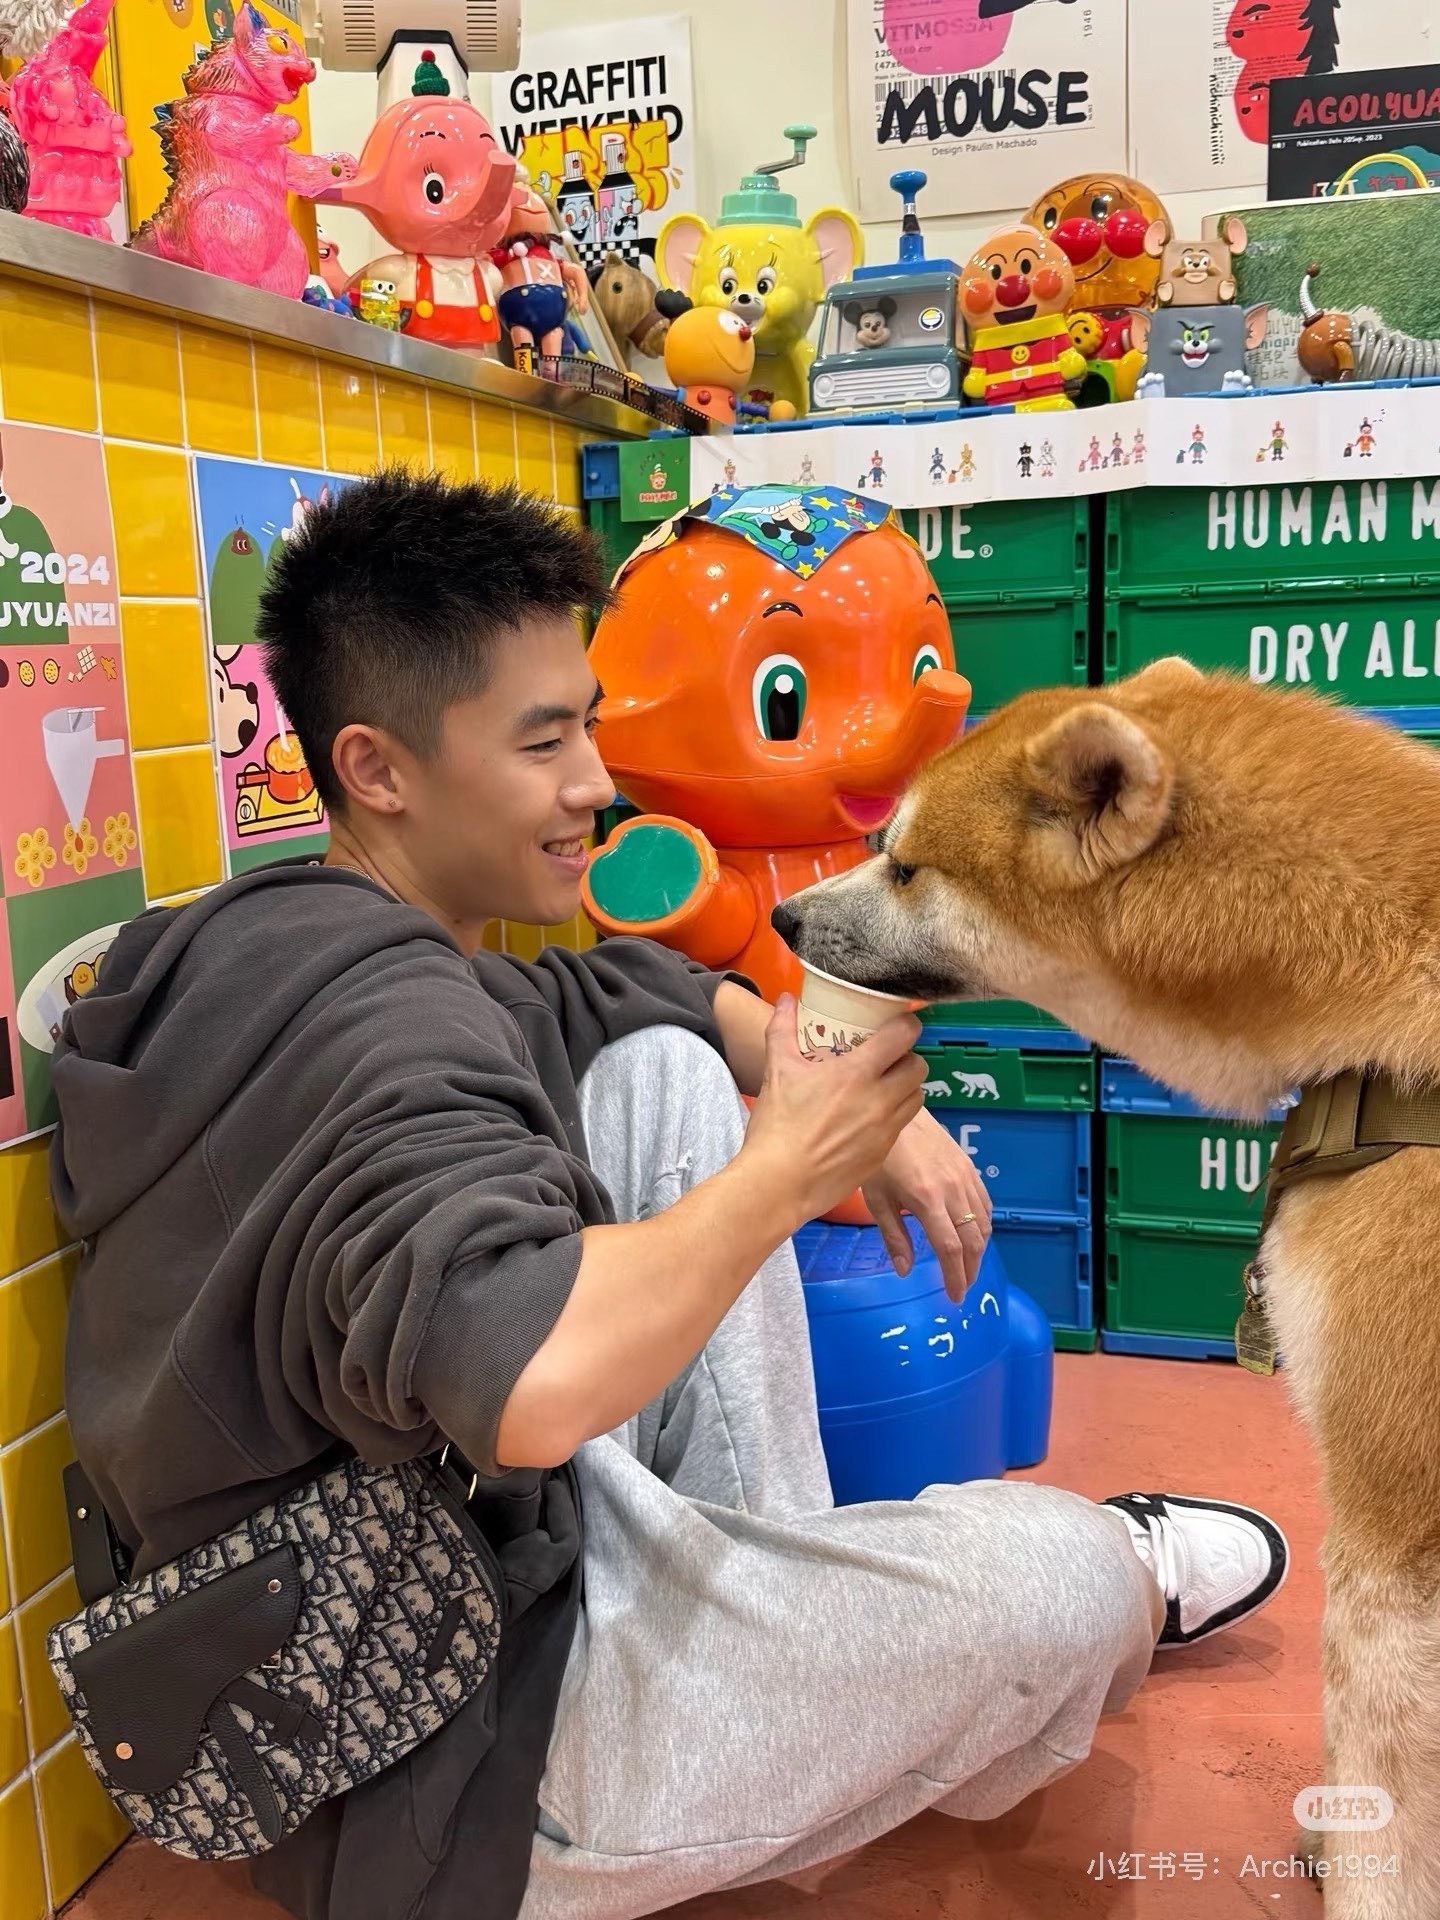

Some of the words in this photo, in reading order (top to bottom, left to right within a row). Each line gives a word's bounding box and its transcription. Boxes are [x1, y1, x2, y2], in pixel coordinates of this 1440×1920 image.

[510, 55, 667, 114] GRAFFITI
[877, 69, 1089, 144] MOUSE
[1293, 93, 1382, 127] AGOU
[932, 145, 963, 156] Design
[996, 138, 1037, 150] Machado
[1207, 480, 1387, 550] HUMAN
[20, 551, 110, 585] 2024
[1249, 622, 1349, 683] DRY
[1364, 619, 1440, 679] AL
[1201, 1136, 1278, 1193] HU
